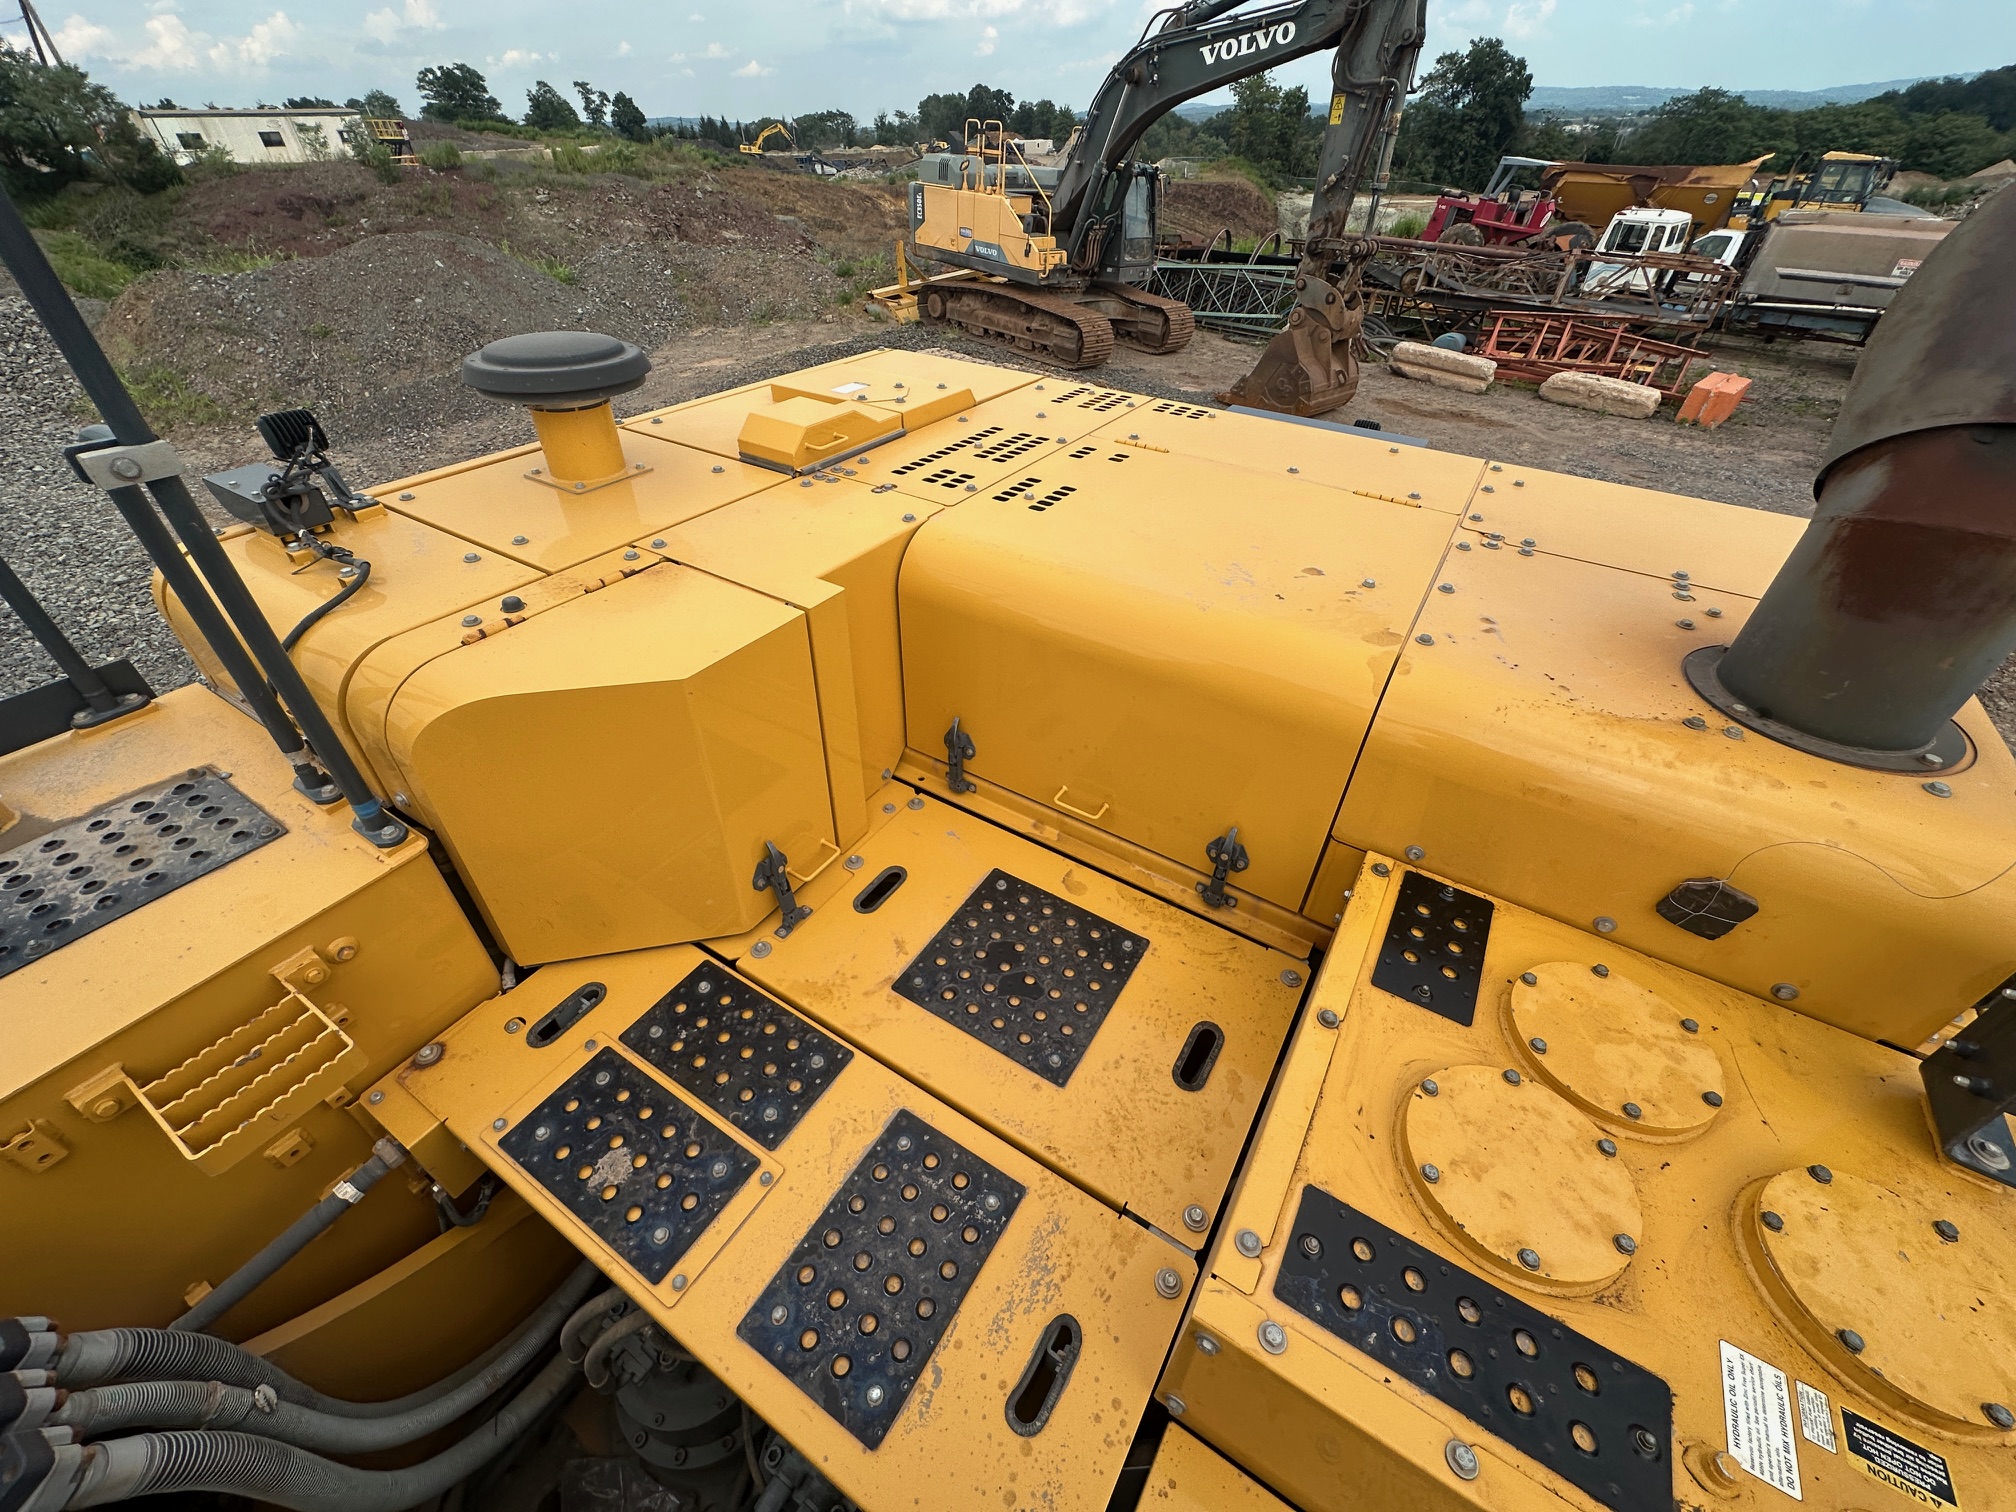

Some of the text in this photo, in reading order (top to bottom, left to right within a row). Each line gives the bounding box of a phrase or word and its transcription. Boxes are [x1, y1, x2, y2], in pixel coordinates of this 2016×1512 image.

[1199, 21, 1296, 66] VOLVO
[975, 245, 997, 256] VOLVO
[1727, 1357, 1735, 1382] ONLY
[1730, 1398, 1741, 1450] HYDRAULIC
[1774, 1373, 1795, 1491] DO NOT MIX HYDRAULIC OILS
[1756, 1435, 1764, 1462] hydraulic
[1853, 1431, 1948, 1486] Release internal pressure by
[1860, 1441, 1937, 1486] DO NOT OPEN HOT.
[1867, 1464, 1927, 1502] CAUTION
[1872, 1454, 1931, 1491] PRESSURIZED.
